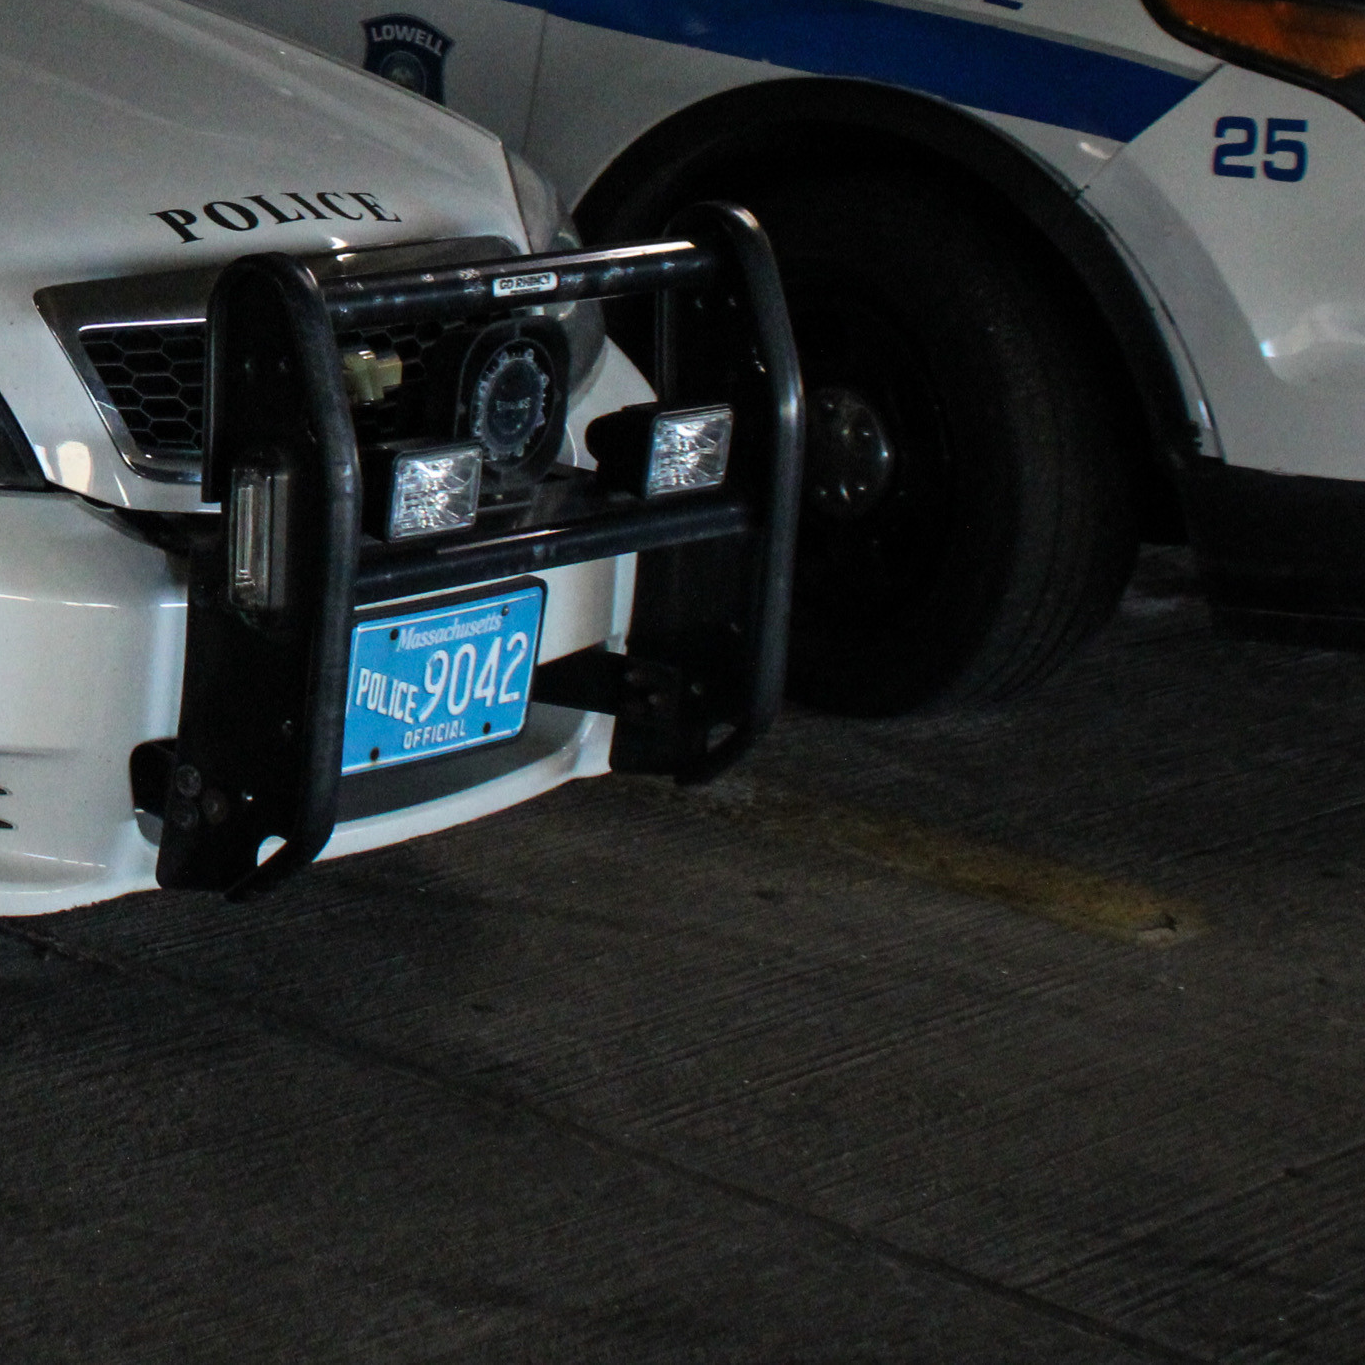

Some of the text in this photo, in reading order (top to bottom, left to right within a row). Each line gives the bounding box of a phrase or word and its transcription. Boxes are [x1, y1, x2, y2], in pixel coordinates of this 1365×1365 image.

[370, 23, 444, 57] LOWELL
[1212, 116, 1308, 183] 25
[149, 192, 402, 244] POLICE
[396, 613, 503, 652] Massachusetts
[355, 631, 529, 725] POLICE 9042
[402, 719, 467, 750] OFFICIAL
